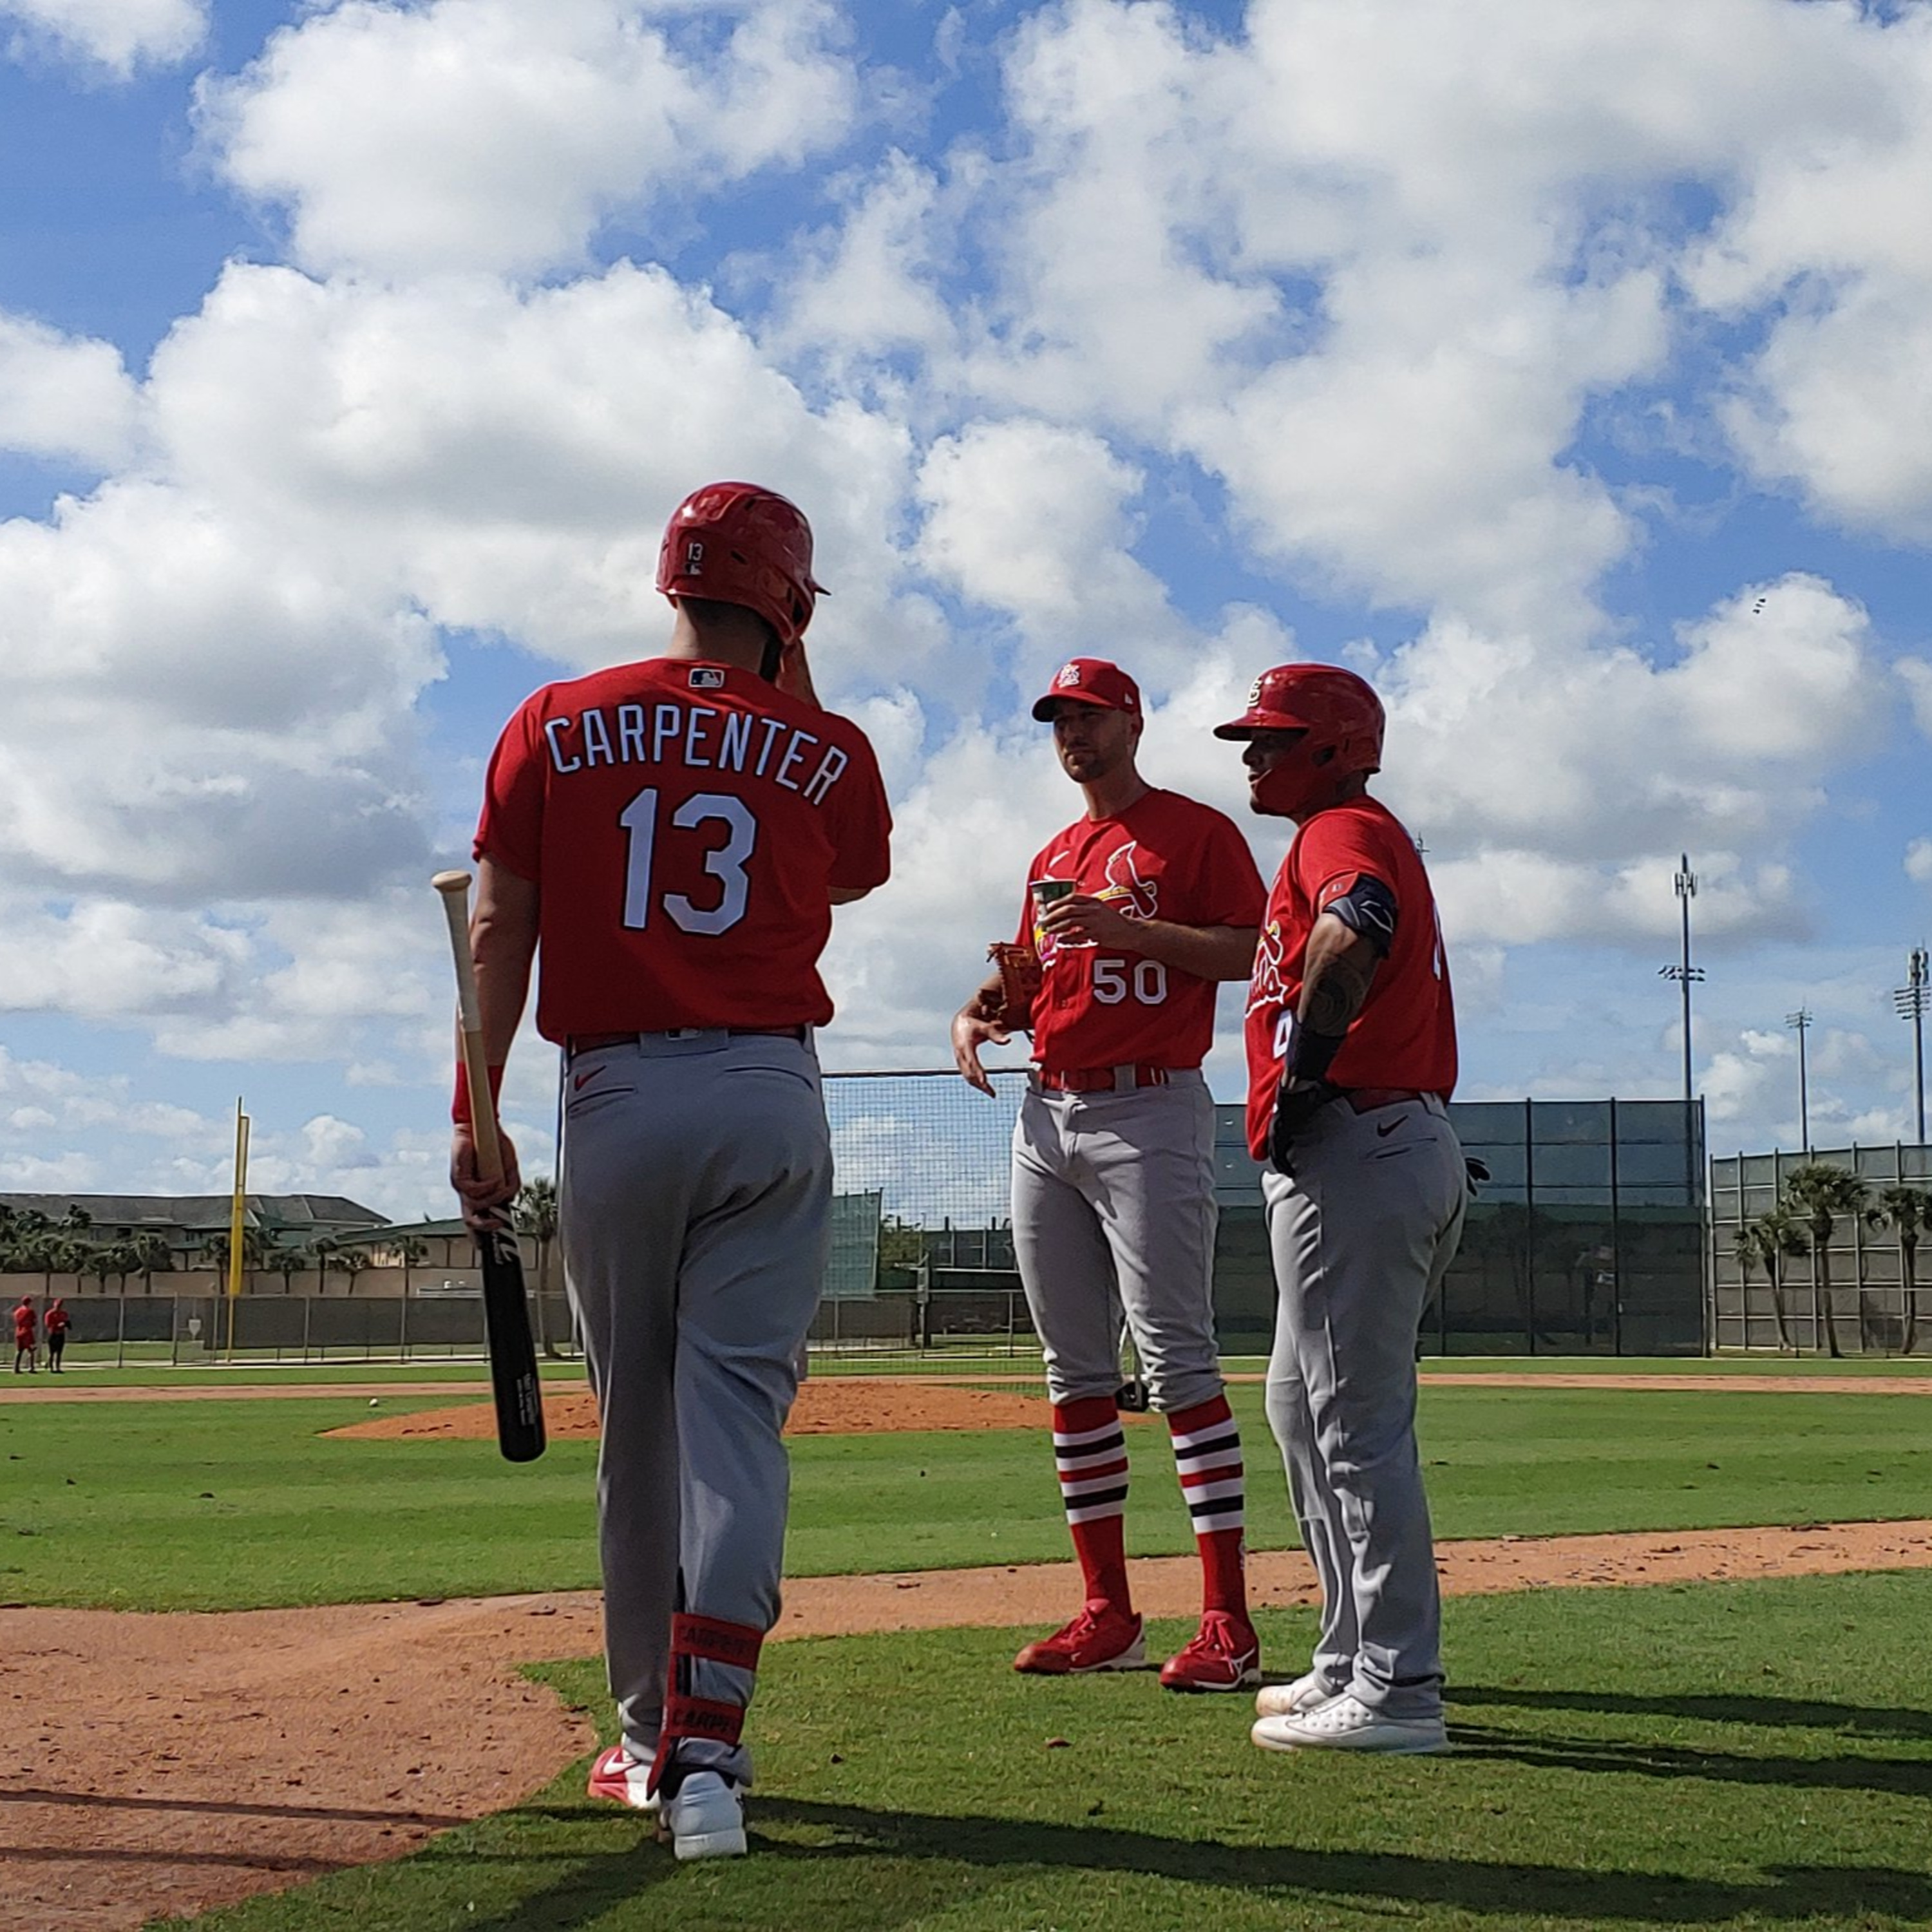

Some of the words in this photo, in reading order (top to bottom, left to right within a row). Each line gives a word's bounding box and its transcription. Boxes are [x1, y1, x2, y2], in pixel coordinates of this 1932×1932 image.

[688, 542, 704, 561] 13
[544, 704, 849, 806] CARPENTER
[620, 788, 757, 936] 13
[1093, 959, 1168, 1005] 50
